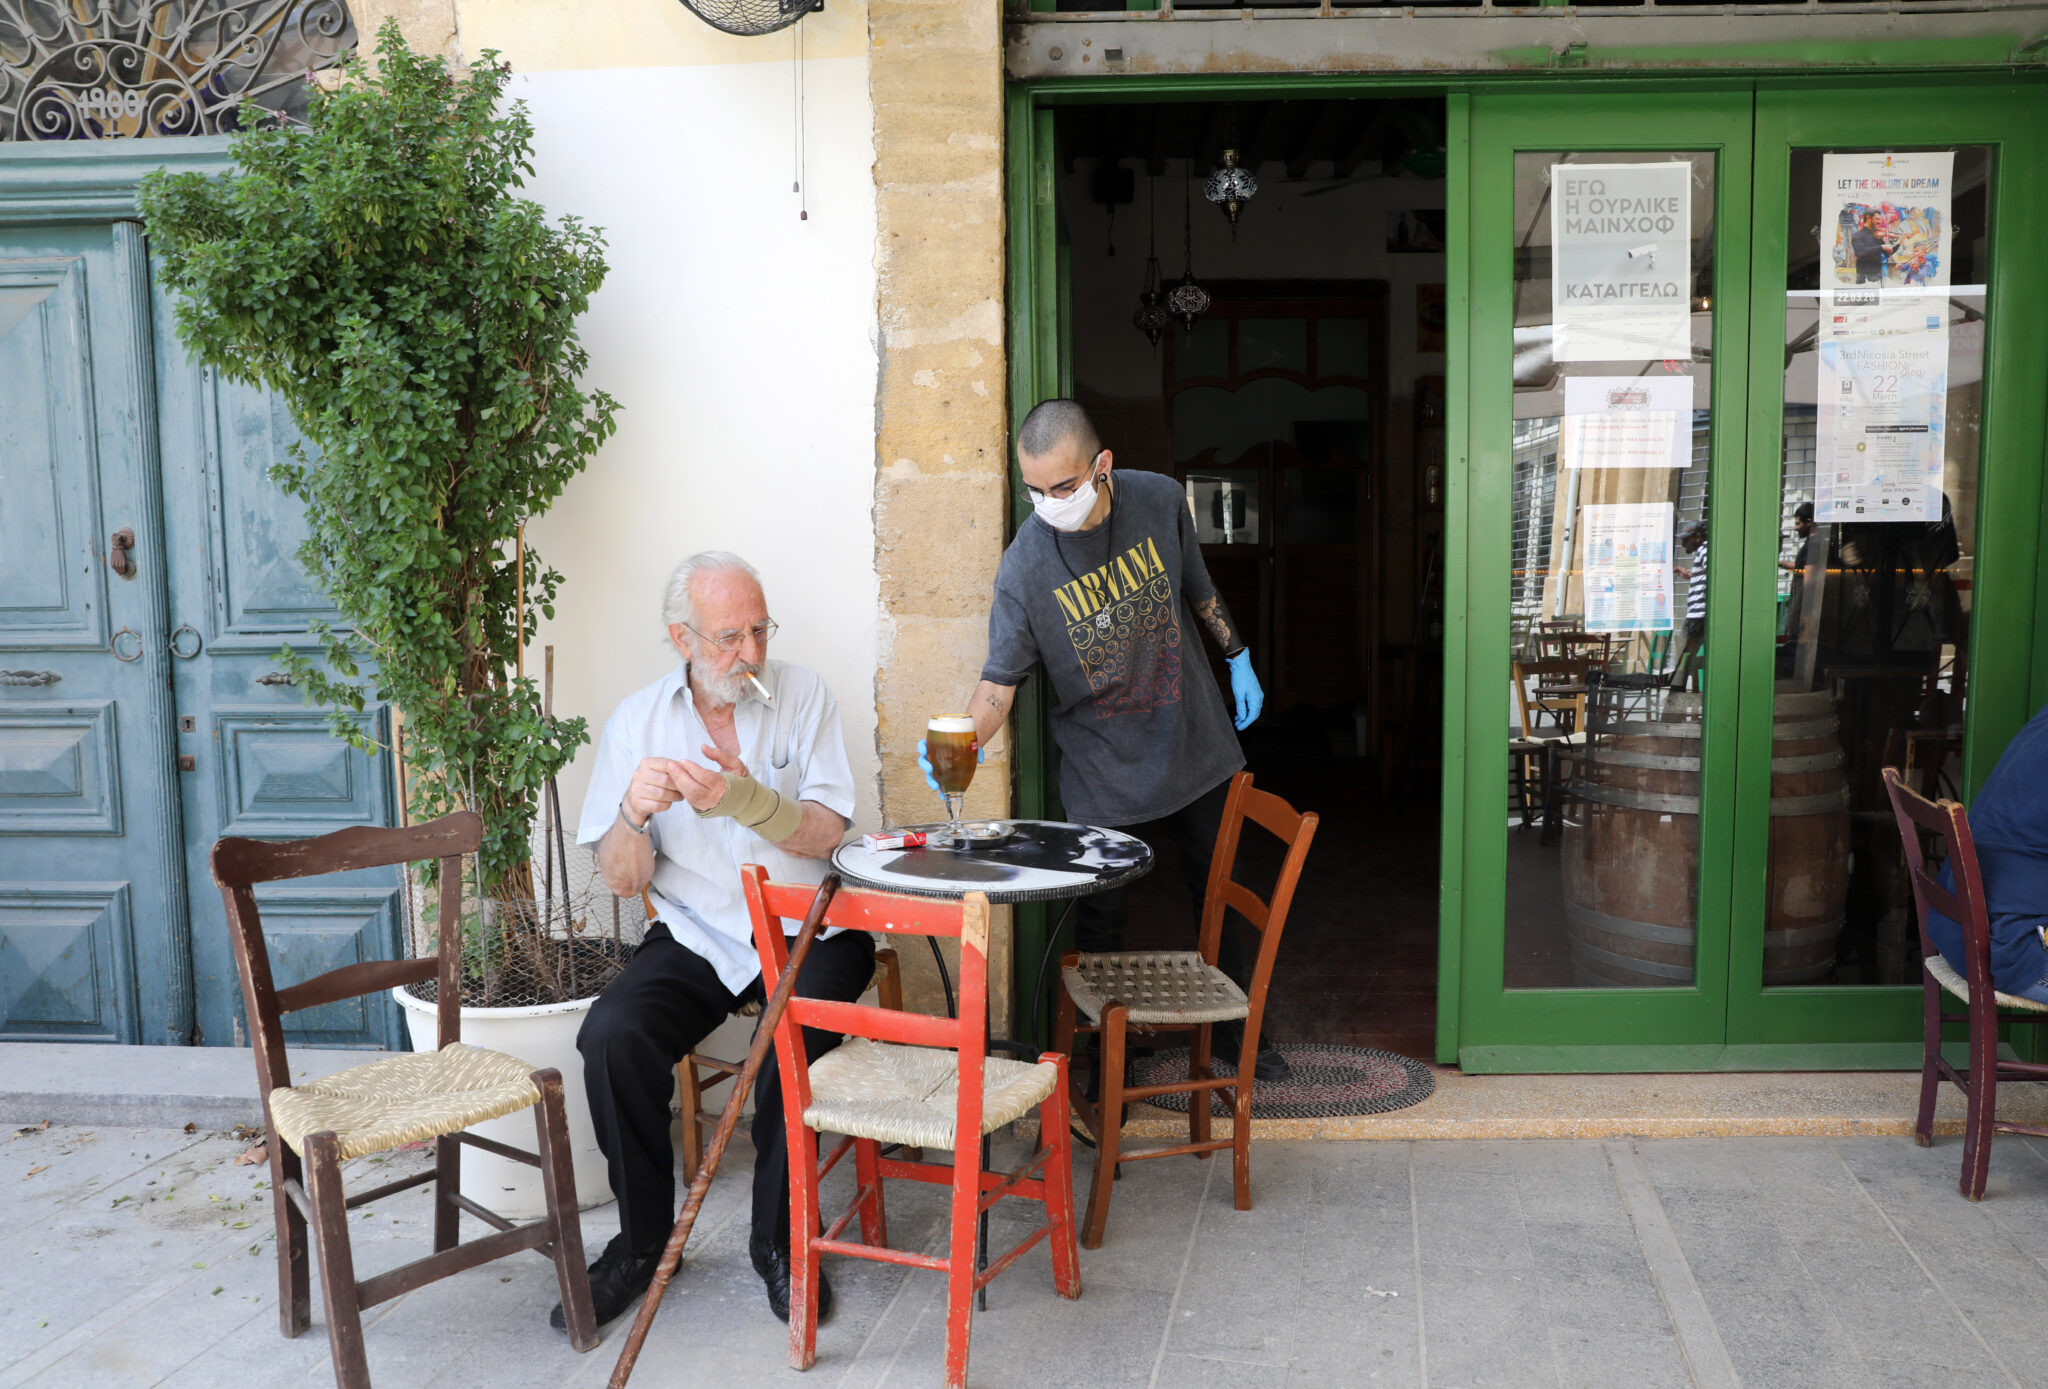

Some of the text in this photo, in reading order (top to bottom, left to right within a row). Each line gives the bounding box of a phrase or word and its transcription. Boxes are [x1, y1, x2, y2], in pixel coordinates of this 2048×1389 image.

[78, 87, 141, 120] 1900
[1565, 179, 1606, 196] ΕΓΩ
[1837, 178, 1940, 190] LET THE CHILDREN DREAM
[1565, 197, 1679, 215] Η ΟΥΡΛΙΚΕ
[1566, 215, 1675, 235] ΜΑΙΝΧΟΦ
[1566, 282, 1679, 299] ΚΑΤΑΓΓΕΛΩ
[1837, 292, 1875, 302] 22.03.20
[1899, 349, 1930, 360] Street
[1856, 361, 1909, 371] FASHION
[1873, 375, 1898, 393] 22
[1872, 393, 1898, 401] March
[1052, 536, 1167, 627] NIRVANA
